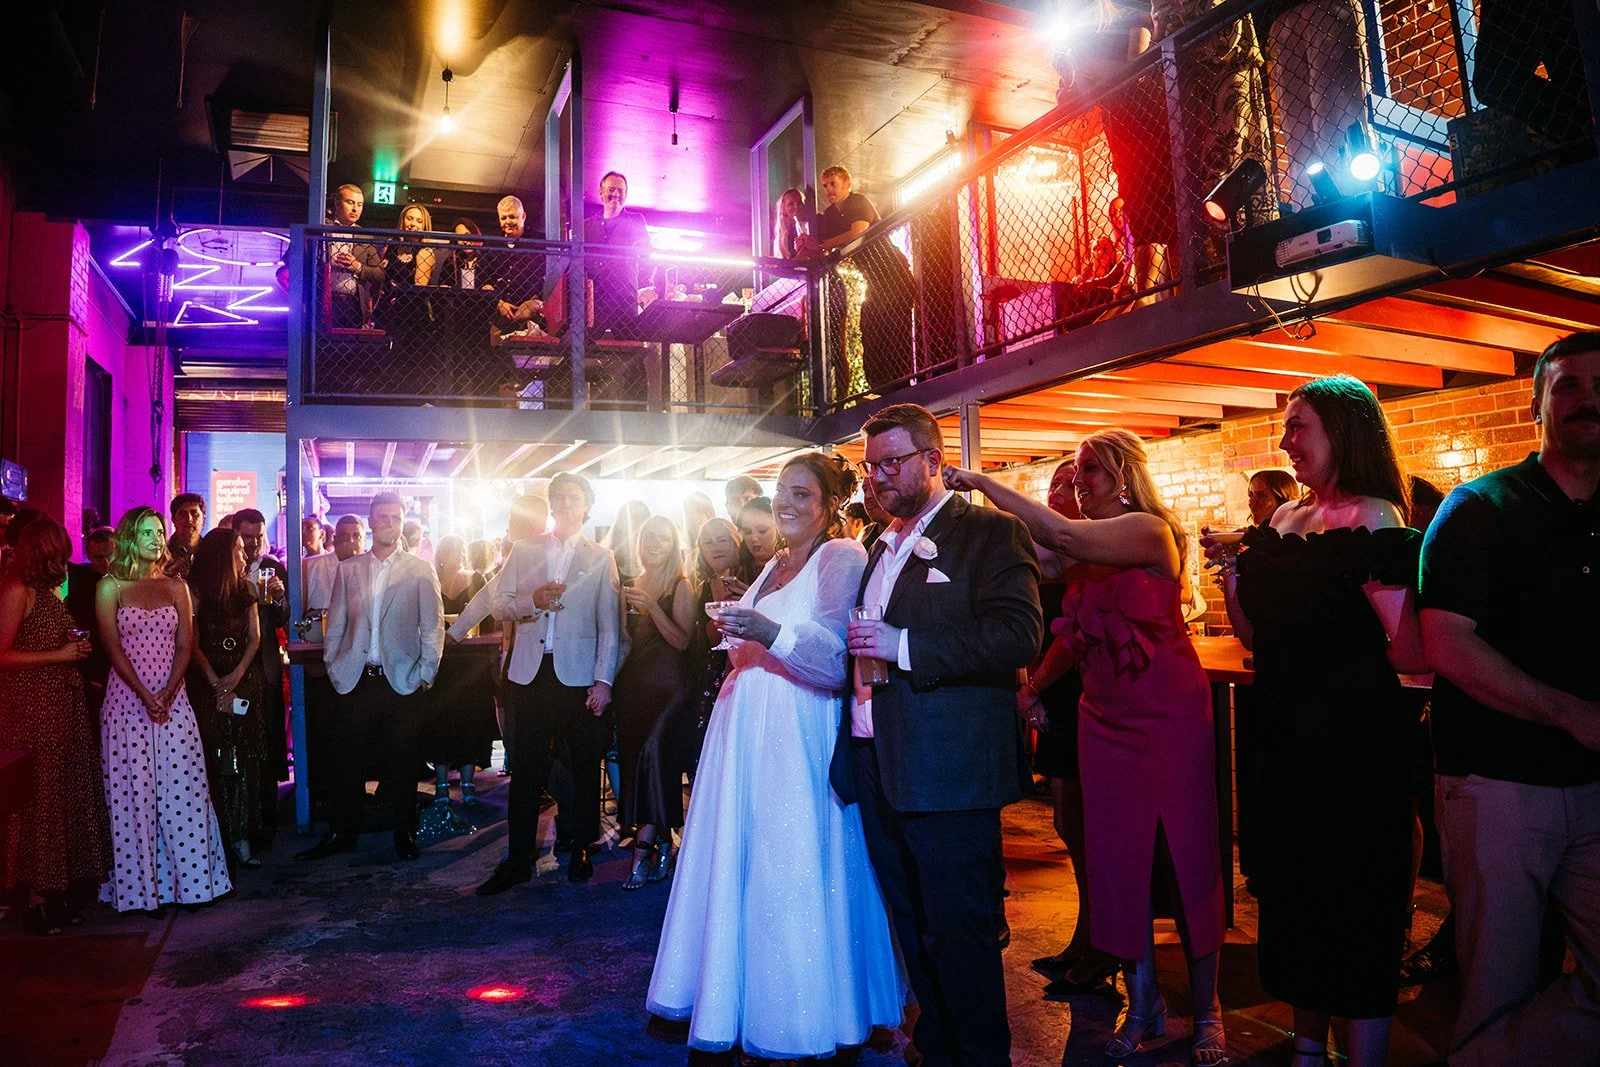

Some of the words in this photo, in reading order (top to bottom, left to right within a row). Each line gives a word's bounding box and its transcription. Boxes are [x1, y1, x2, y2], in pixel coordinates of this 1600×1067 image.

[216, 476, 250, 489] gender
[216, 486, 250, 495] neutral
[216, 495, 244, 504] toilets
[216, 504, 233, 512] this
